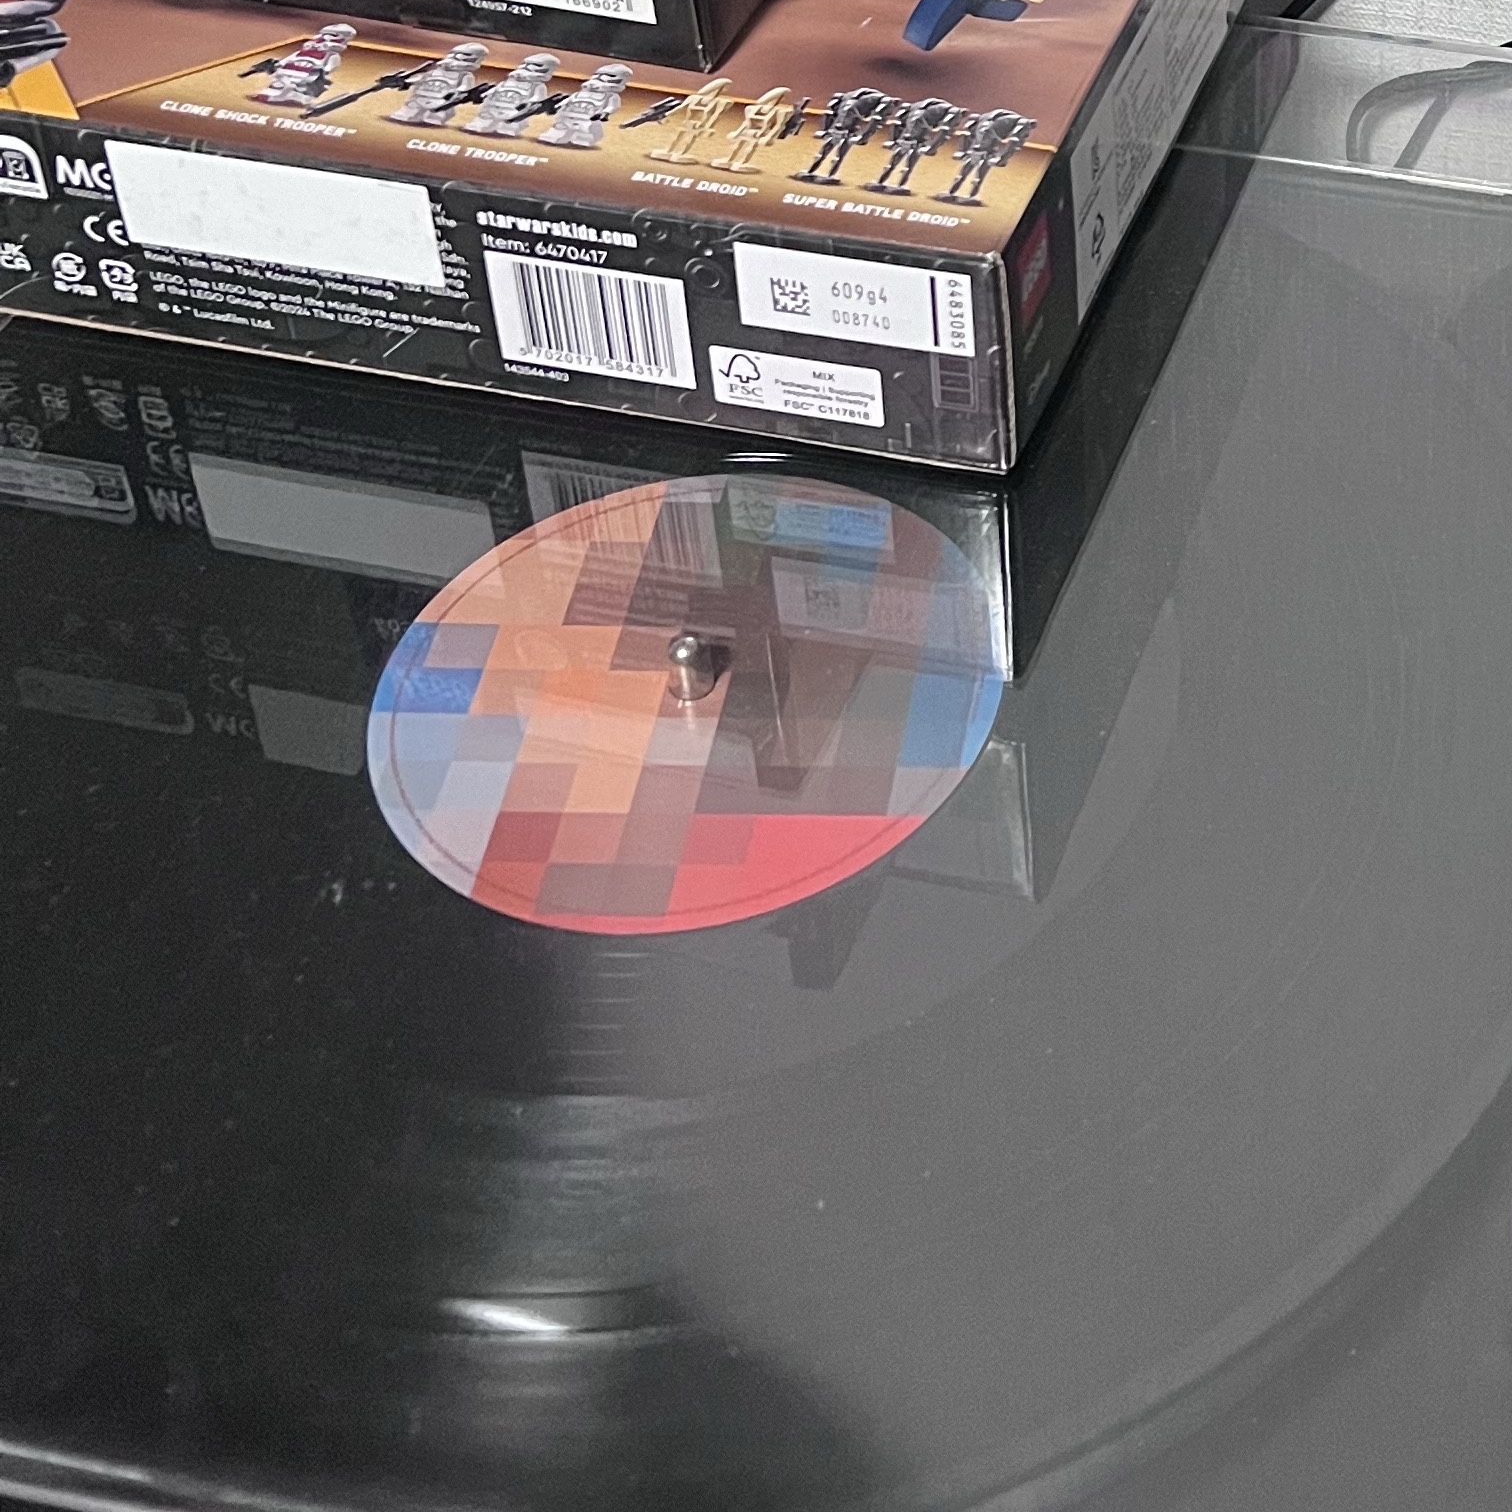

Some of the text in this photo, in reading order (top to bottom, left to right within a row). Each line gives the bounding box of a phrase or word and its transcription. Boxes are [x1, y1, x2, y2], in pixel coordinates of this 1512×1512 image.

[160, 99, 213, 117] CLONE
[214, 108, 271, 126] SHOCK
[406, 138, 461, 156] CLONE
[631, 171, 695, 189] BATTLE
[782, 193, 840, 211] SUPER
[841, 202, 905, 220] BATTLE
[476, 210, 638, 249] starwarskids.com
[481, 233, 608, 264] Item: 6470417
[211, 281, 246, 295] LEGO
[831, 281, 889, 305] 609g4
[189, 288, 225, 302] LEGO
[337, 312, 373, 327] LEGO
[832, 309, 891, 330] 008740
[947, 278, 967, 350] 6483085
[534, 347, 593, 366] 702017
[606, 361, 665, 378] 584317
[728, 383, 763, 398] FSC
